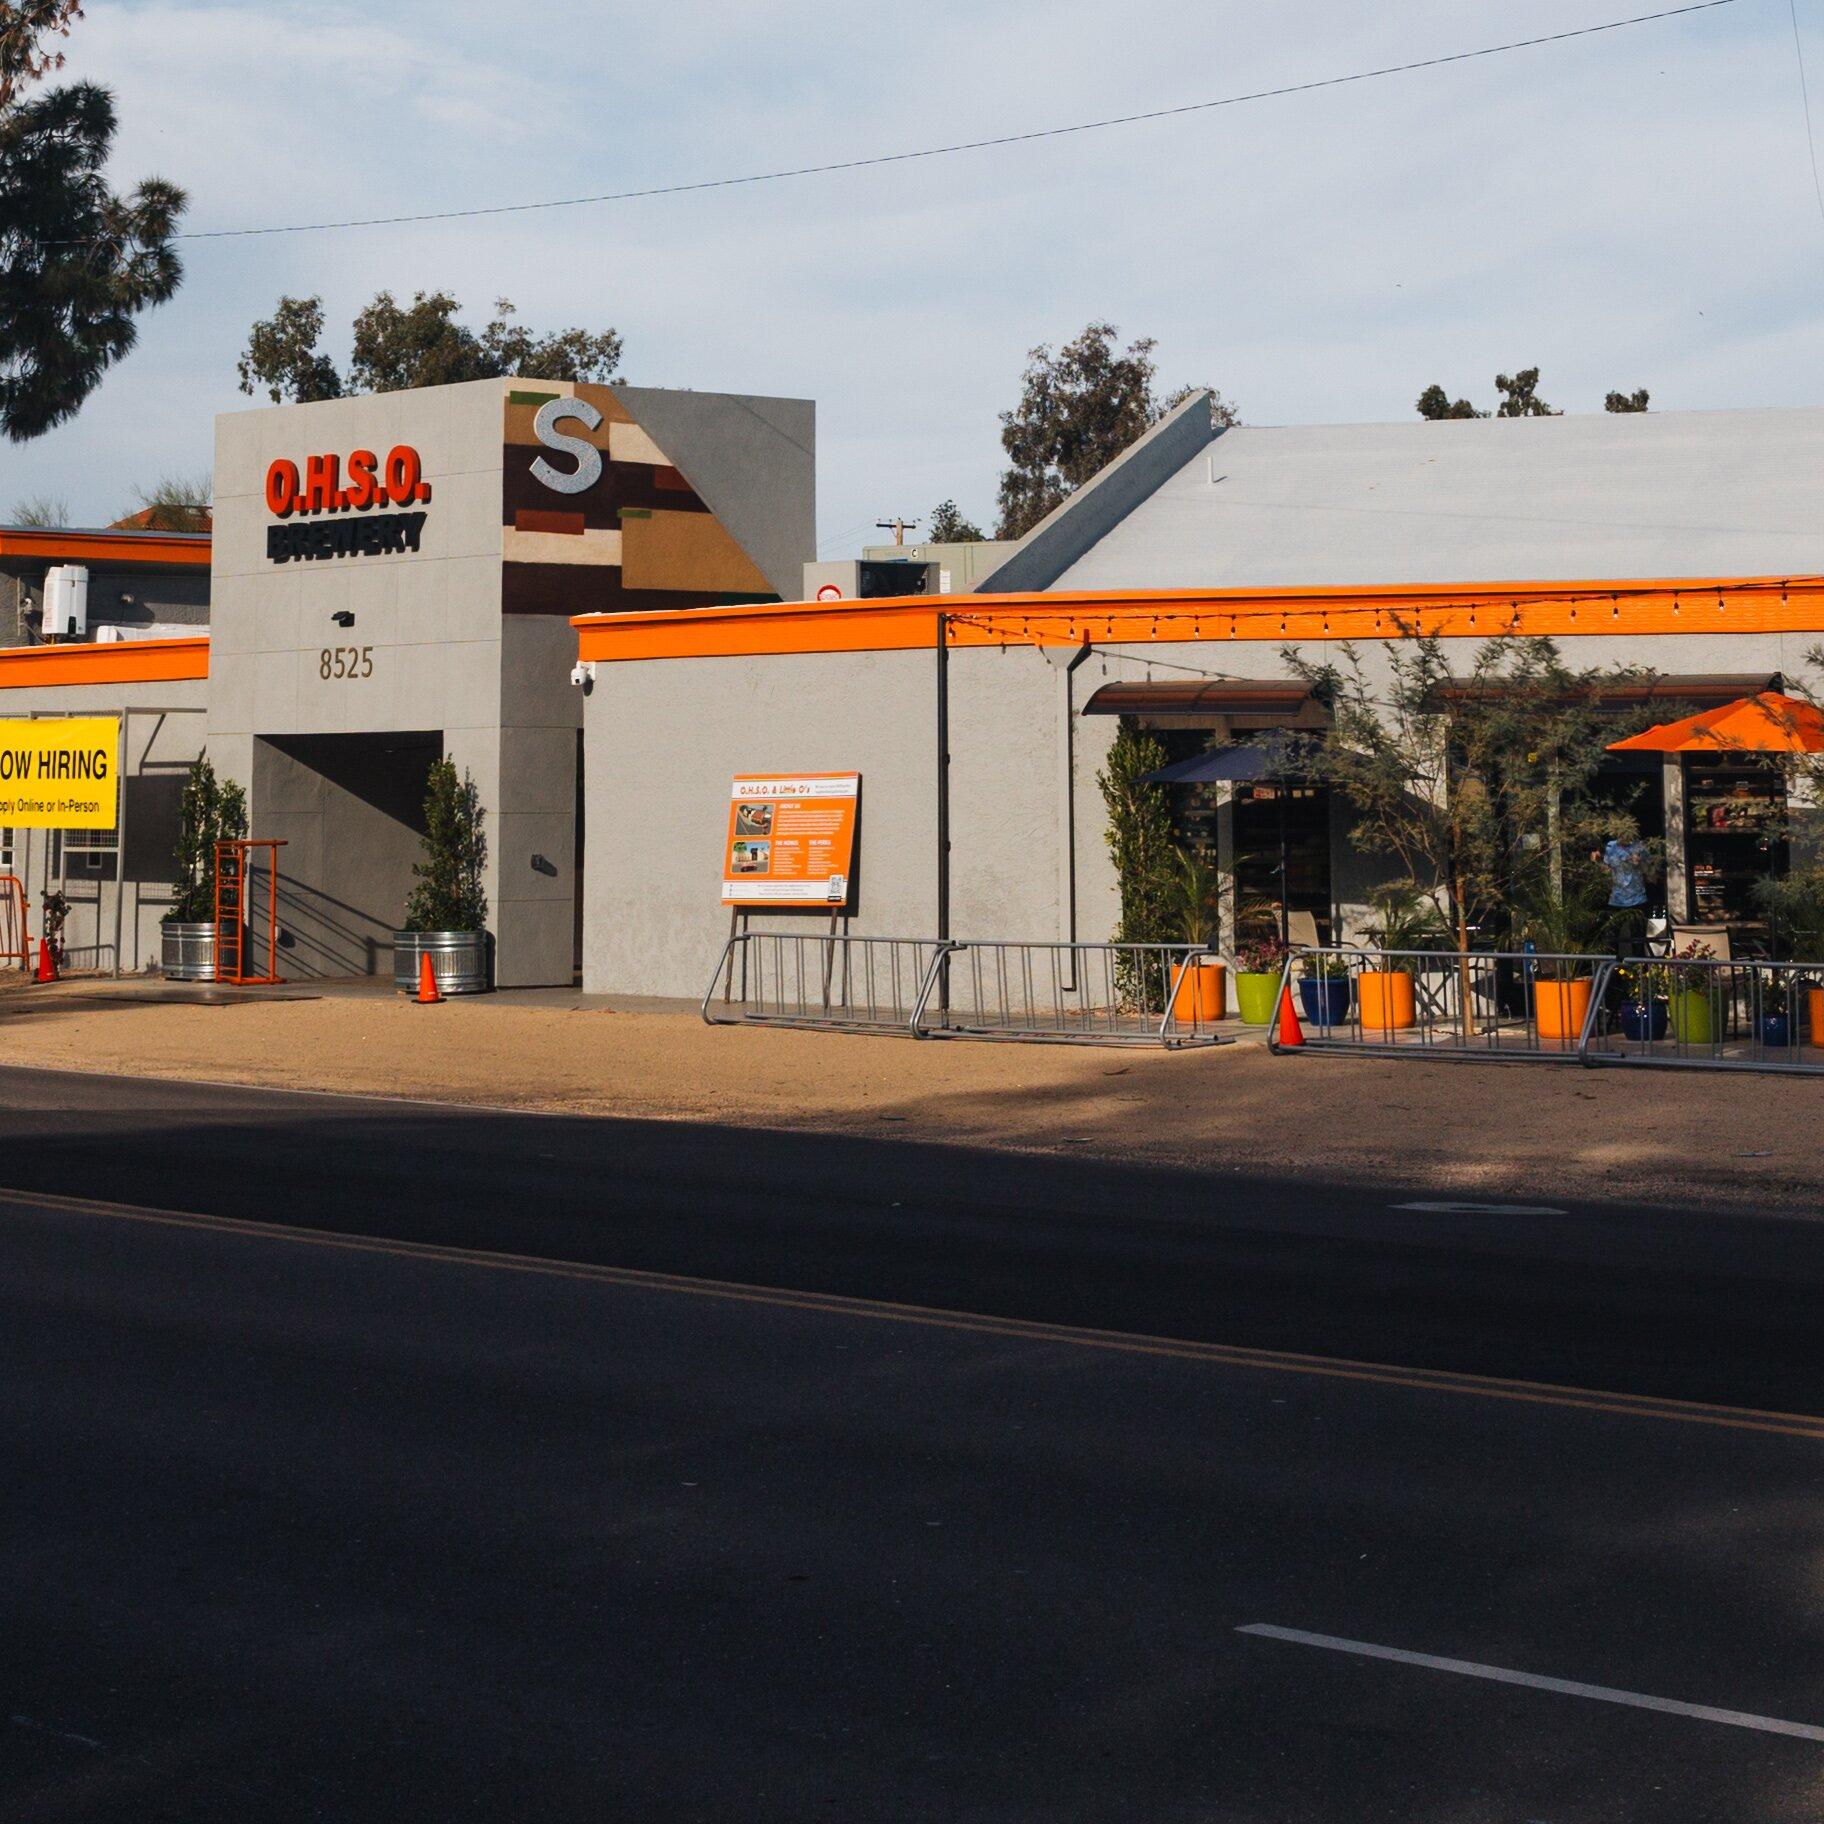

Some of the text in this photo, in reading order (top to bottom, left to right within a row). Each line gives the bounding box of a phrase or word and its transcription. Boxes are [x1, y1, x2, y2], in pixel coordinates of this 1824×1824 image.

[529, 397, 603, 495] S
[265, 445, 431, 516] O.H.S.O.
[267, 511, 428, 563] BREWERY
[319, 646, 374, 680] 8525
[38, 749, 107, 780] HIRING
[17, 798, 44, 812] Online
[46, 802, 56, 813] or
[58, 798, 100, 813] In-Person
